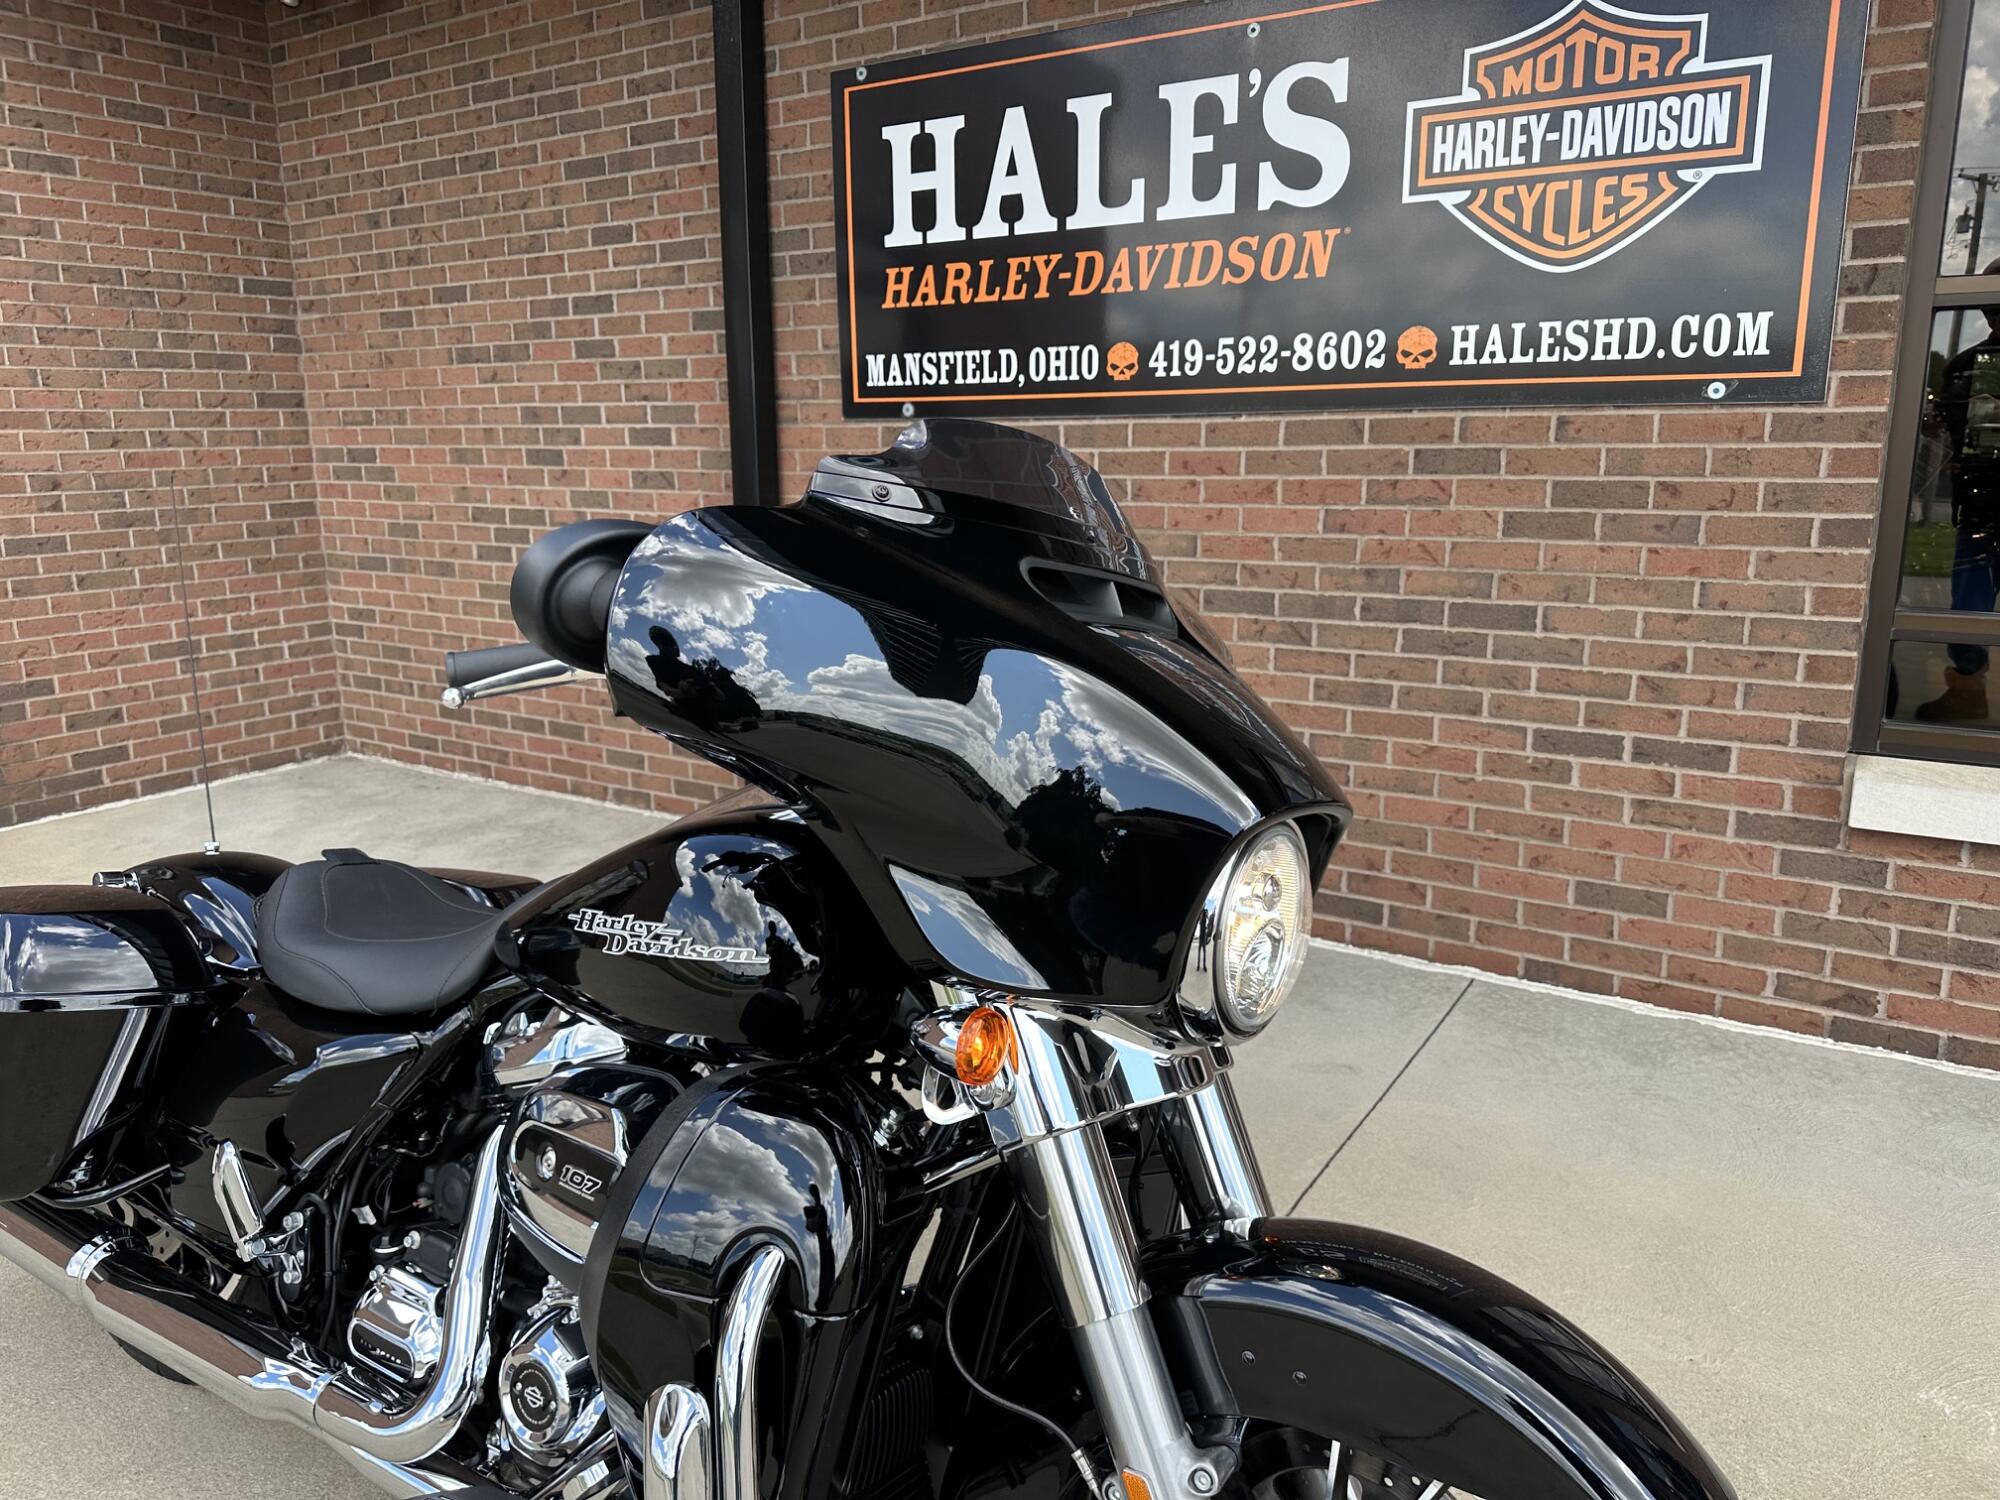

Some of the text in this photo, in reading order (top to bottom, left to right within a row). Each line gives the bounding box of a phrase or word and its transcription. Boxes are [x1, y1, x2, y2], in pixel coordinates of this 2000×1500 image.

[1502, 27, 1660, 98] MOTOR
[881, 56, 1351, 249] HALE'S
[1432, 90, 1732, 174] HARLEY-DAVIDSON
[1493, 172, 1650, 246] CYCLES
[881, 228, 1340, 309] HARLEY-DAVIDSON
[1148, 328, 1387, 379] 419-522-8602
[1448, 310, 1774, 367] HALESHD.COM
[600, 932, 770, 963] Davidson
[560, 1164, 602, 1194] 107
